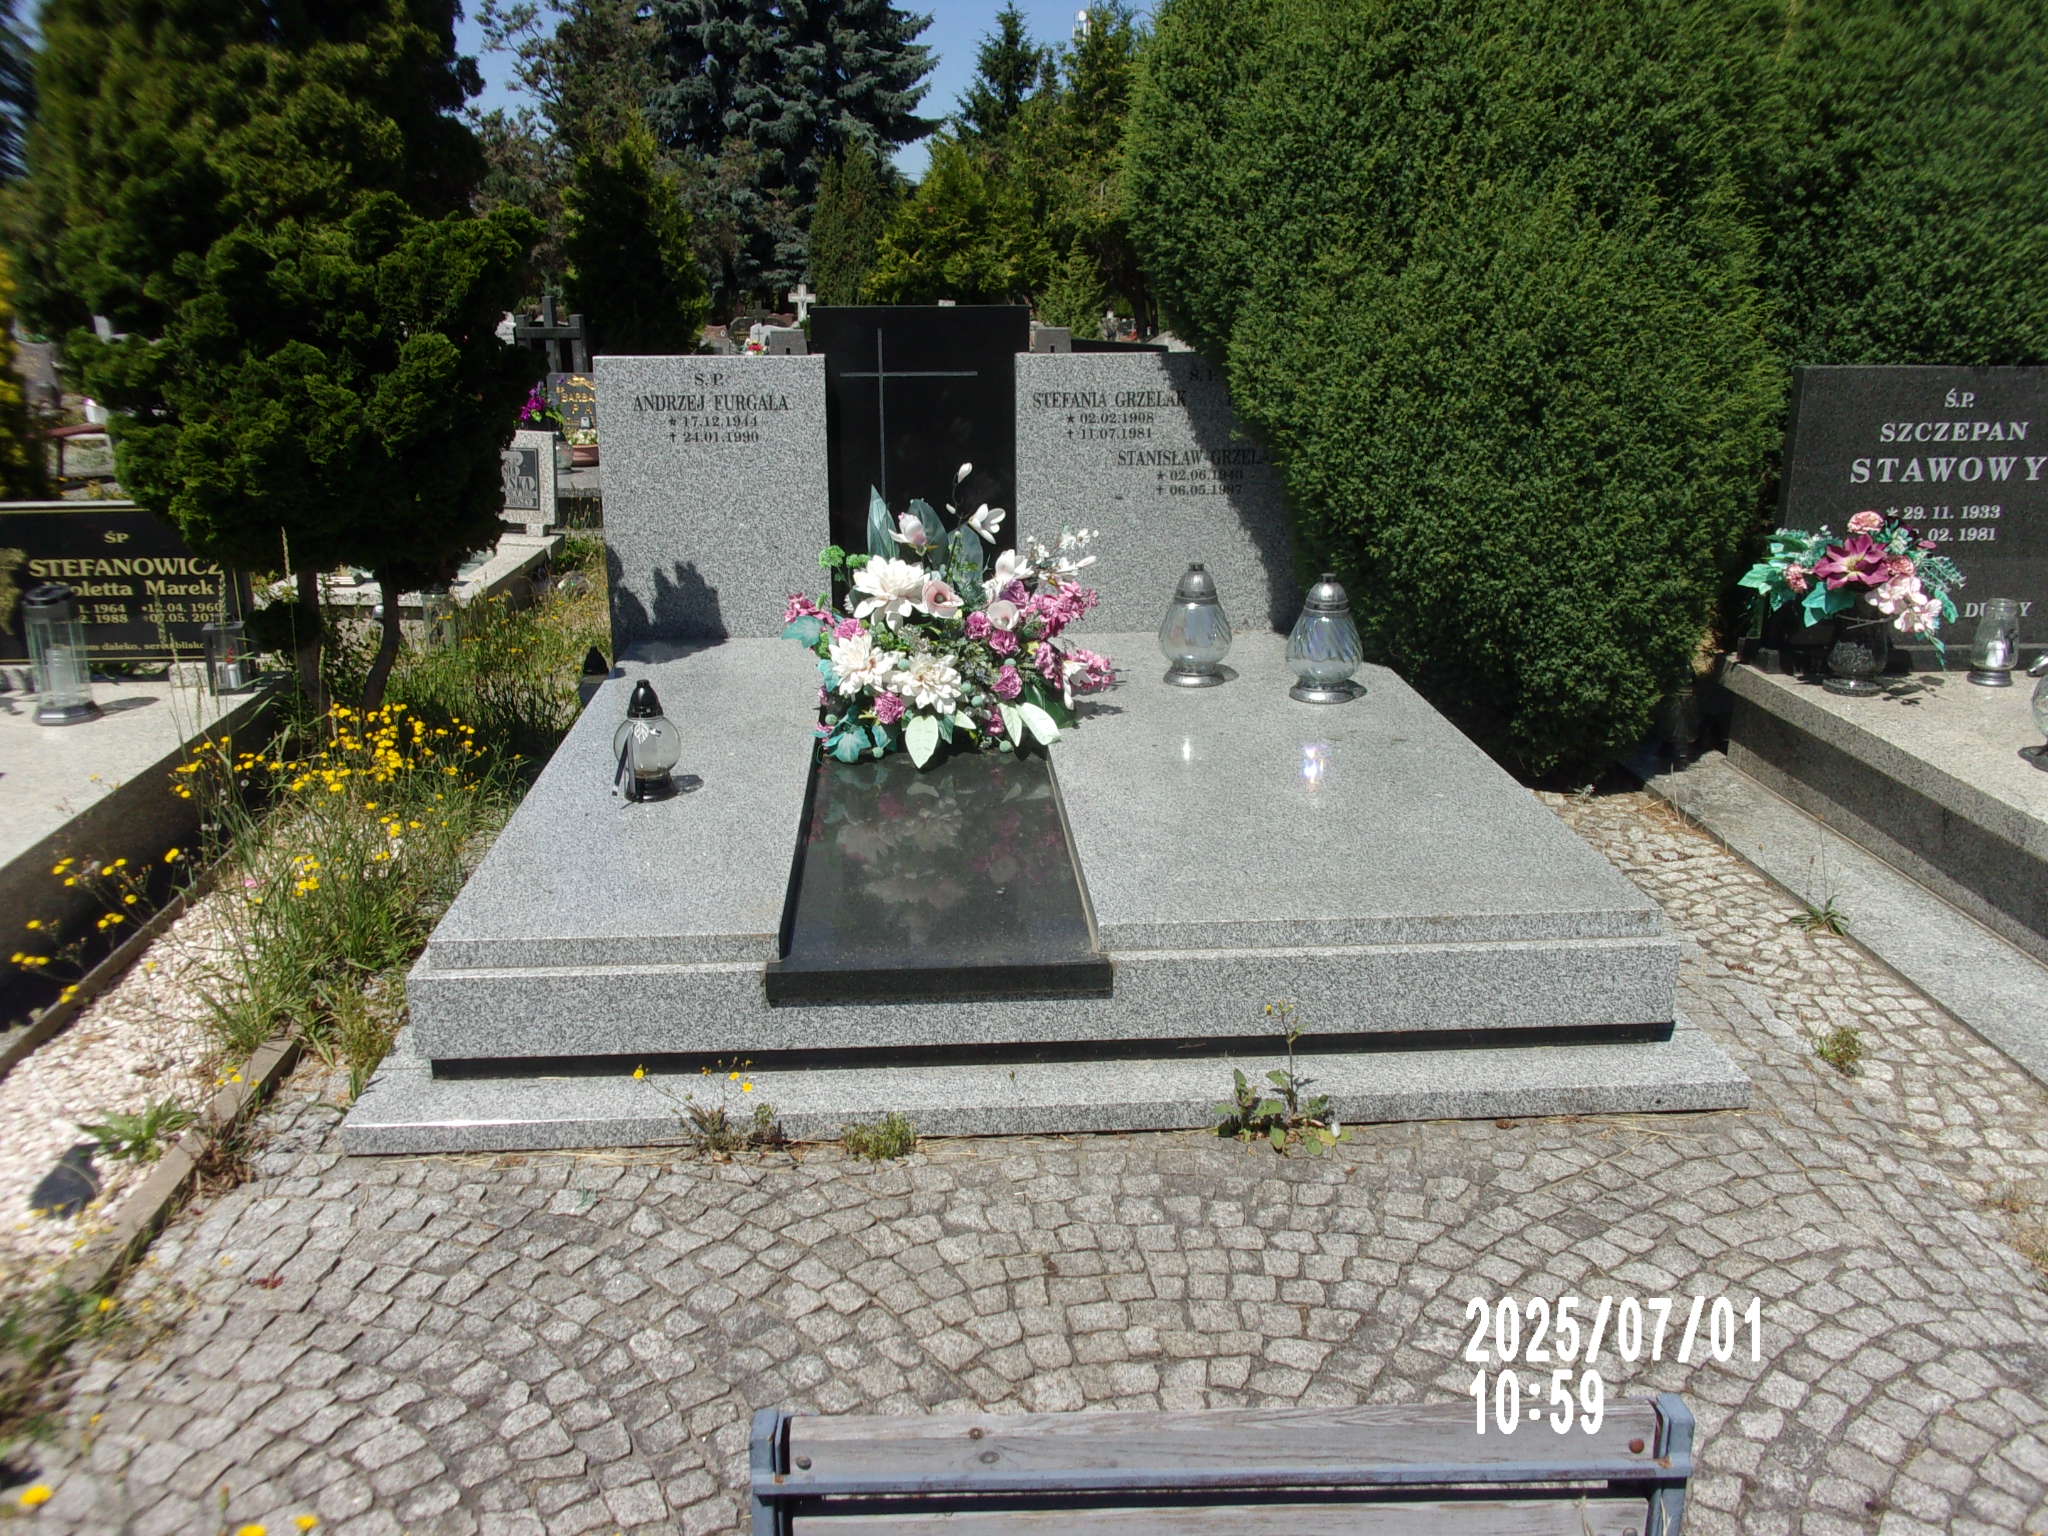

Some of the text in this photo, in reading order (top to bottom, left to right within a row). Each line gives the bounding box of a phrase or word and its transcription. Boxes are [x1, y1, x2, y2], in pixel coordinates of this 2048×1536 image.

[633, 394, 706, 411] ANDRZEJ
[1032, 390, 1187, 408] STEFANIA GRZELAK
[1879, 422, 2030, 442] SZCZEPAN
[1850, 456, 2048, 484] STAWOWY
[1932, 505, 1954, 520] 11.
[1960, 504, 2001, 520] 1933
[1928, 528, 1953, 543] 02.
[1958, 527, 1996, 542] 1981
[145, 579, 215, 596] Marek
